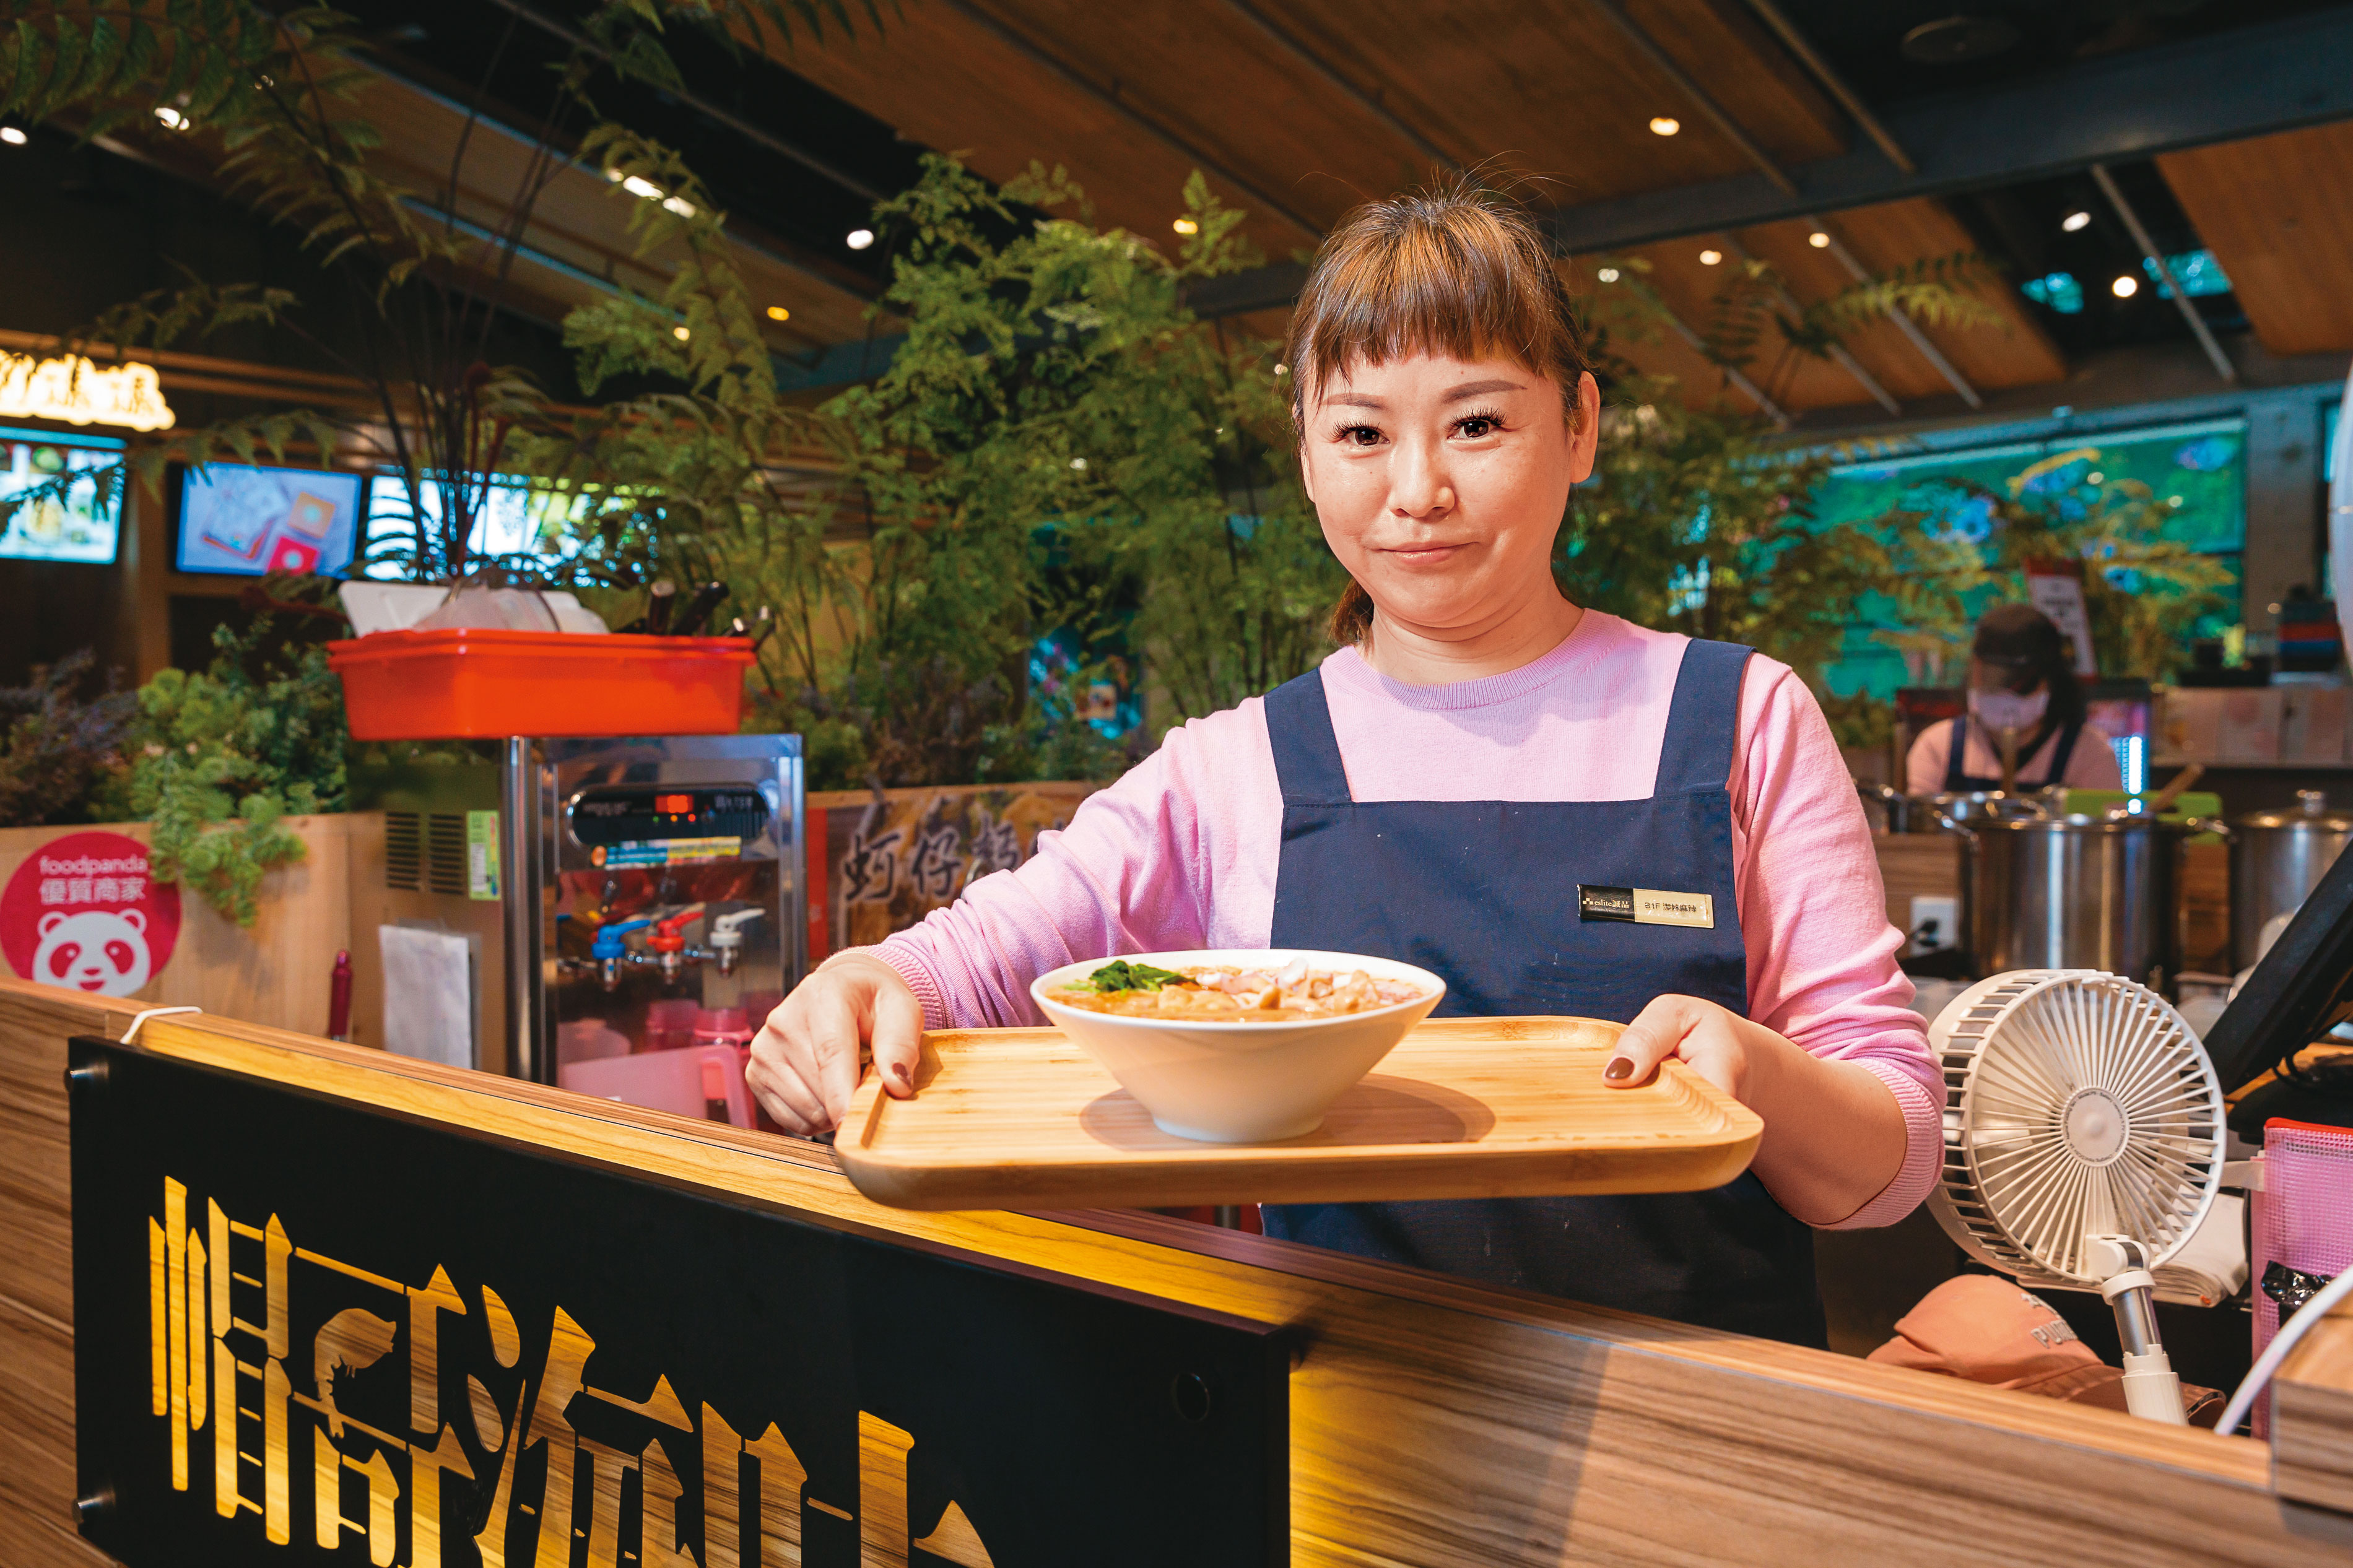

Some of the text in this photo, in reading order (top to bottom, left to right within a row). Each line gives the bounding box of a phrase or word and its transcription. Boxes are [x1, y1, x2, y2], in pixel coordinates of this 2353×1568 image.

[40, 854, 148, 876] foodpanda
[39, 877, 146, 906] 優質商家
[2031, 1319, 2078, 1349] PUM
